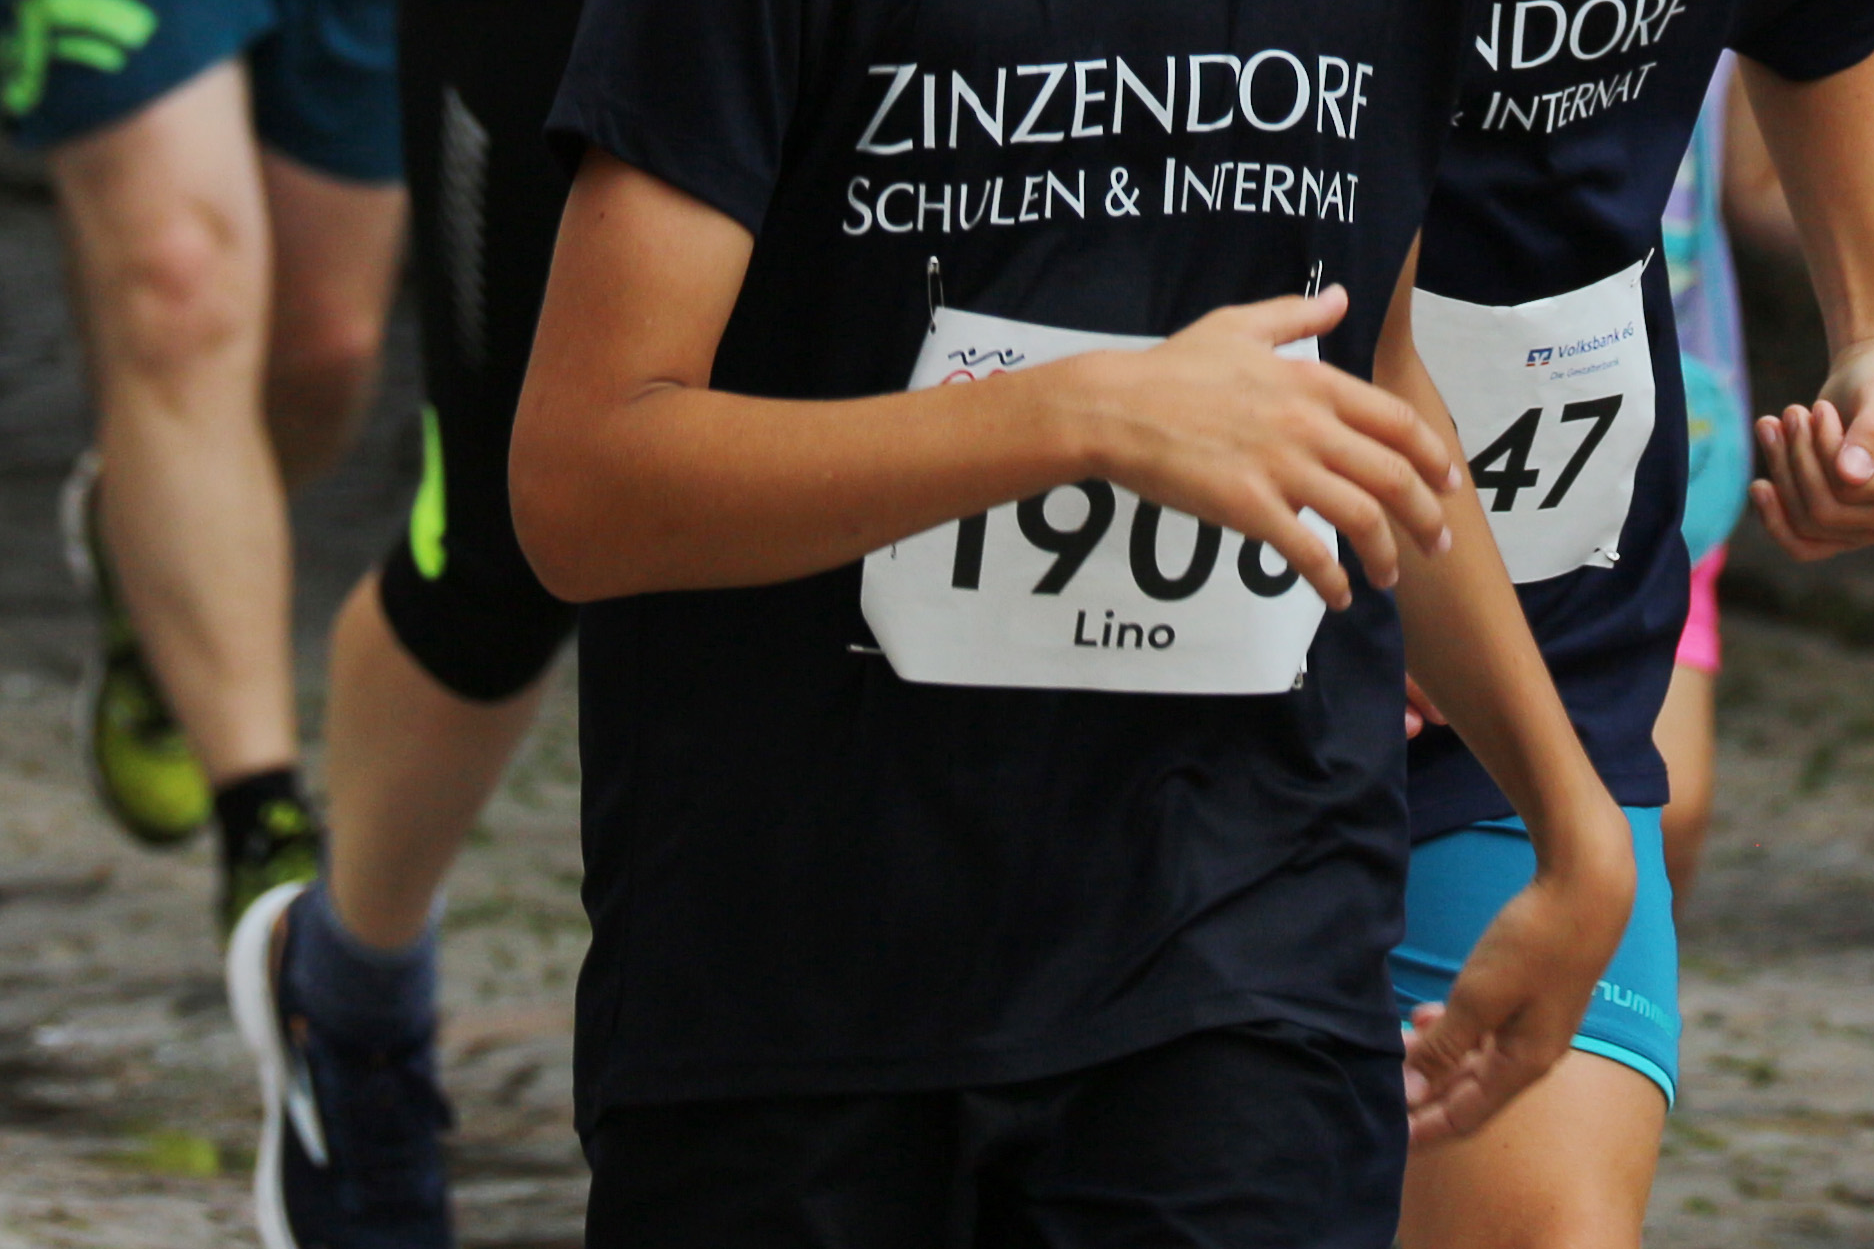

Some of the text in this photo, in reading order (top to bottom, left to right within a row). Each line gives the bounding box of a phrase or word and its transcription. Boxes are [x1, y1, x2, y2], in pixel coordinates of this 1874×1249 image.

[856, 48, 1374, 155] ZINZENDORF
[1104, 165, 1141, 217] &
[1558, 328, 1620, 359] Volksbank
[1450, 393, 1624, 513] 47
[1073, 608, 1176, 651] Lino
